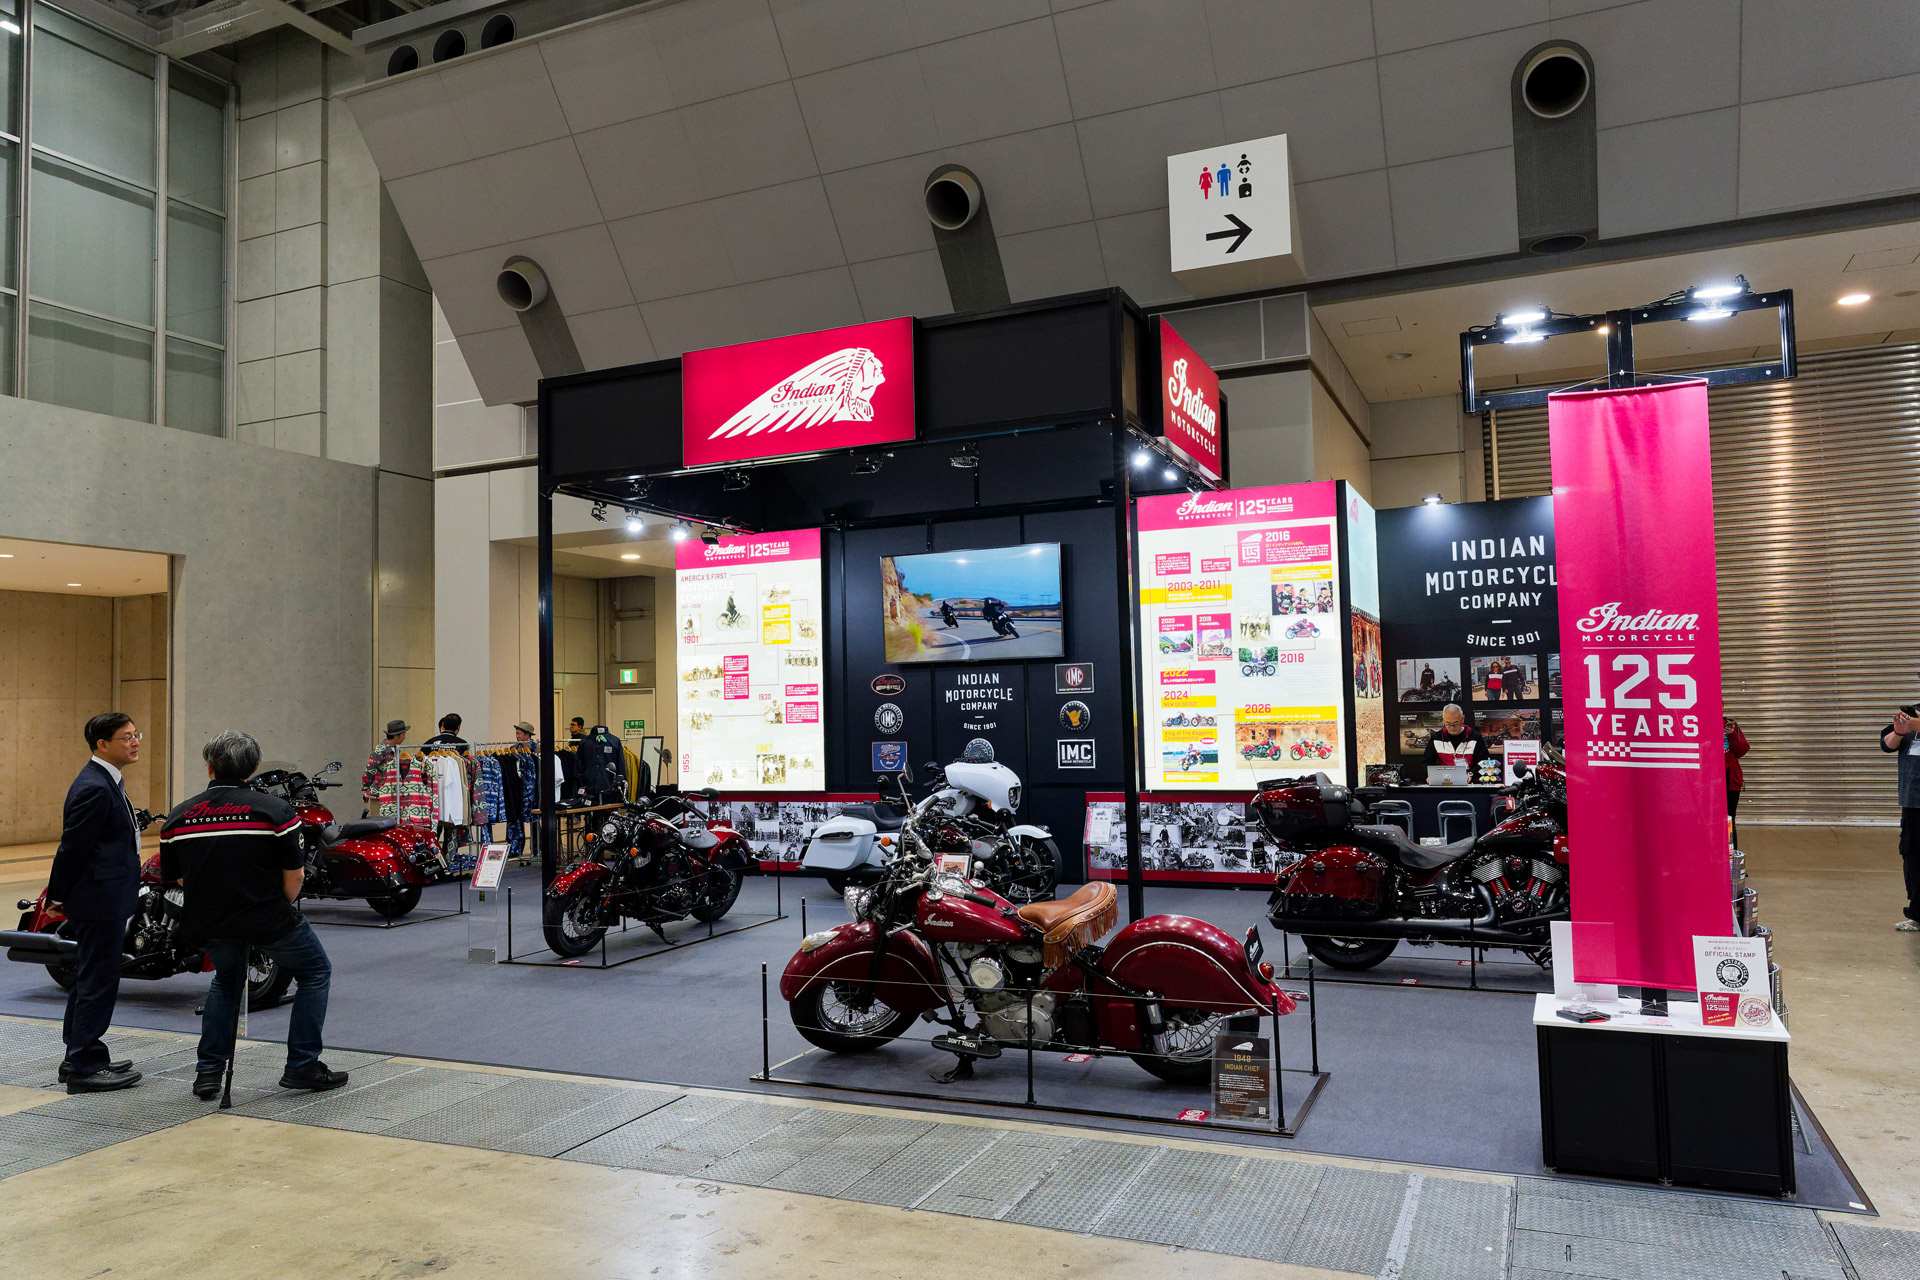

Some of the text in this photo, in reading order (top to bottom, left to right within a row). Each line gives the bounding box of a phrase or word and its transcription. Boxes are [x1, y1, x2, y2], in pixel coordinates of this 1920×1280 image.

[771, 381, 836, 403] Indian
[1168, 358, 1216, 437] Indian
[773, 396, 834, 408] MOTORCYCLE
[1171, 410, 1216, 456] MOTORCYCLE
[1176, 497, 1293, 516] Indian 125 YEARS
[1178, 512, 1232, 521] MOTORCYCLE
[1265, 531, 1290, 542] 2016
[704, 543, 746, 557] Indian
[750, 544, 770, 557] 125
[1452, 535, 1545, 561] INDIAN
[681, 572, 727, 582] AMERICA'S FIRST
[1426, 565, 1558, 596] MOTORCYCL
[1460, 592, 1542, 609] COMPANY
[1577, 602, 1699, 632] Indian
[684, 636, 699, 644] 1901
[1466, 631, 1541, 646] SINCE 1901
[1582, 634, 1695, 642] MOTORCYCLE
[1281, 653, 1305, 664] 2018
[1067, 668, 1083, 686] IMC
[1163, 667, 1188, 677] 2022
[957, 673, 1000, 685] INDIAN
[1583, 654, 1698, 709] 125
[945, 687, 1013, 703] MOTORCYCLE
[1164, 691, 1189, 701] 2024
[961, 702, 998, 711] COMPANY
[1245, 704, 1272, 714] 2026
[963, 722, 997, 731] SINCE 1901
[1586, 714, 1699, 737] YEARS
[756, 744, 773, 752] 1967
[1061, 744, 1091, 760] IMC
[184, 800, 252, 818] Indian
[185, 815, 250, 824] MOTORCYCLE
[1724, 958, 1749, 980] MOTORCYCLE
[961, 1041, 977, 1049] TOUCH
[1233, 1054, 1252, 1063] 1948
[1224, 1063, 1261, 1072] INDIAN CHIEF
